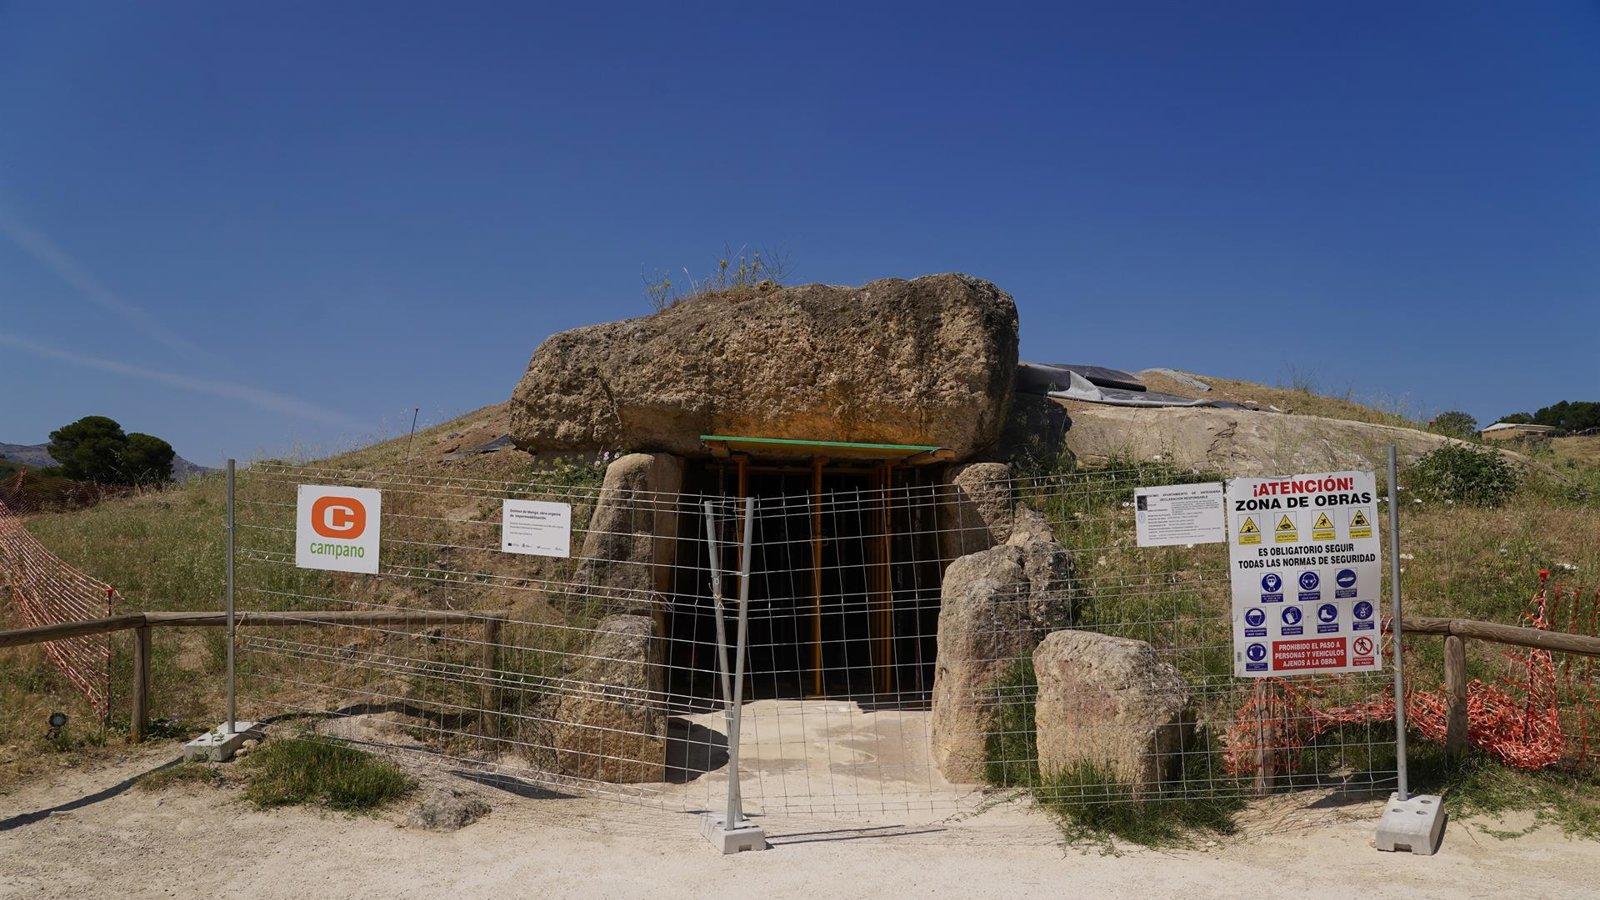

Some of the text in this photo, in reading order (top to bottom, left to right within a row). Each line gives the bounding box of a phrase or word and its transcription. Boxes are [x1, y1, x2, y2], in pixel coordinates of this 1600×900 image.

[1253, 475, 1354, 497] ¡ATENCIÓN!
[1235, 492, 1372, 511] ZONA DE OBRAS
[310, 542, 365, 559] campano
[1258, 543, 1354, 557] ES OBLIGATORIO SEGUIR
[1238, 553, 1376, 569] TODAS LAS NORMAS DE SEGURIDAD
[1275, 651, 1306, 659] PERSONAS
[1311, 649, 1345, 657] VEHICULOS
[1279, 643, 1310, 651] PROHIBIDO
